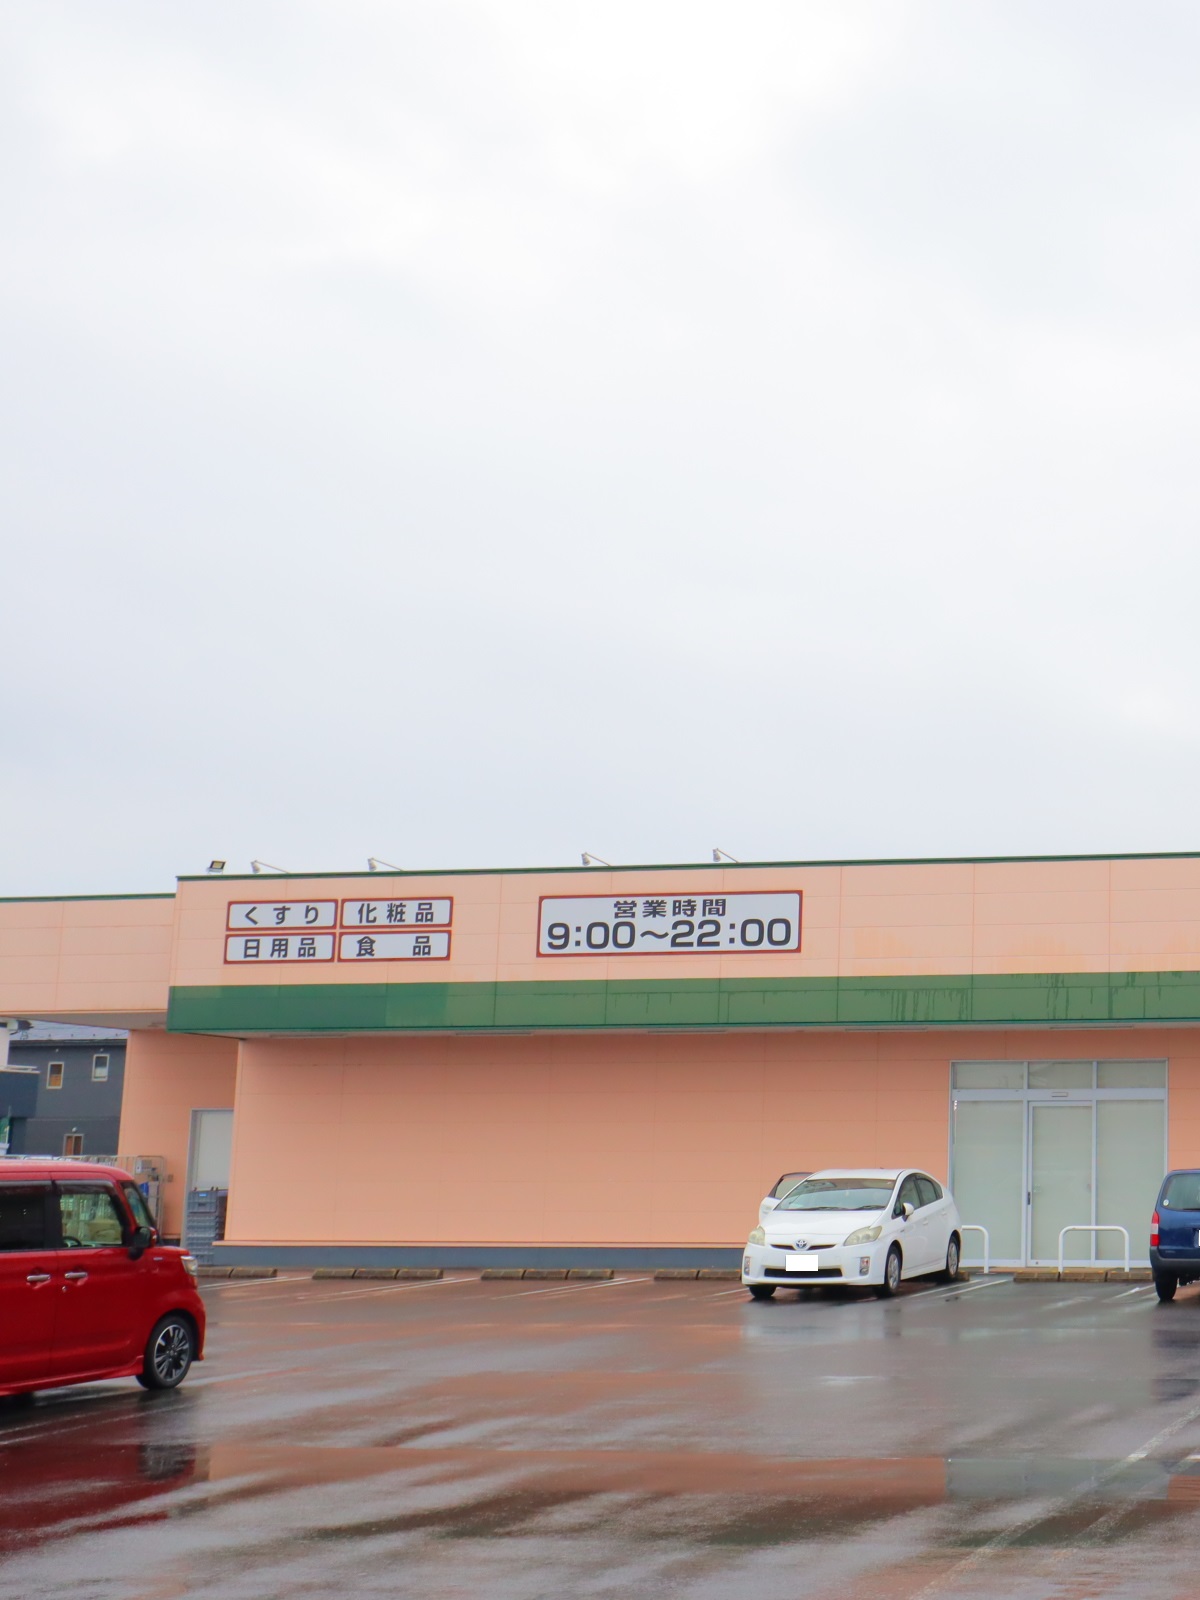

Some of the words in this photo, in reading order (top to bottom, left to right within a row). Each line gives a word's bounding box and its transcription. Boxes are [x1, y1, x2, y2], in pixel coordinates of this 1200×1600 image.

[244, 905, 319, 925] くすり
[358, 902, 434, 924] 化粧品
[613, 898, 727, 918] 営業時間
[243, 937, 316, 958] 日用品
